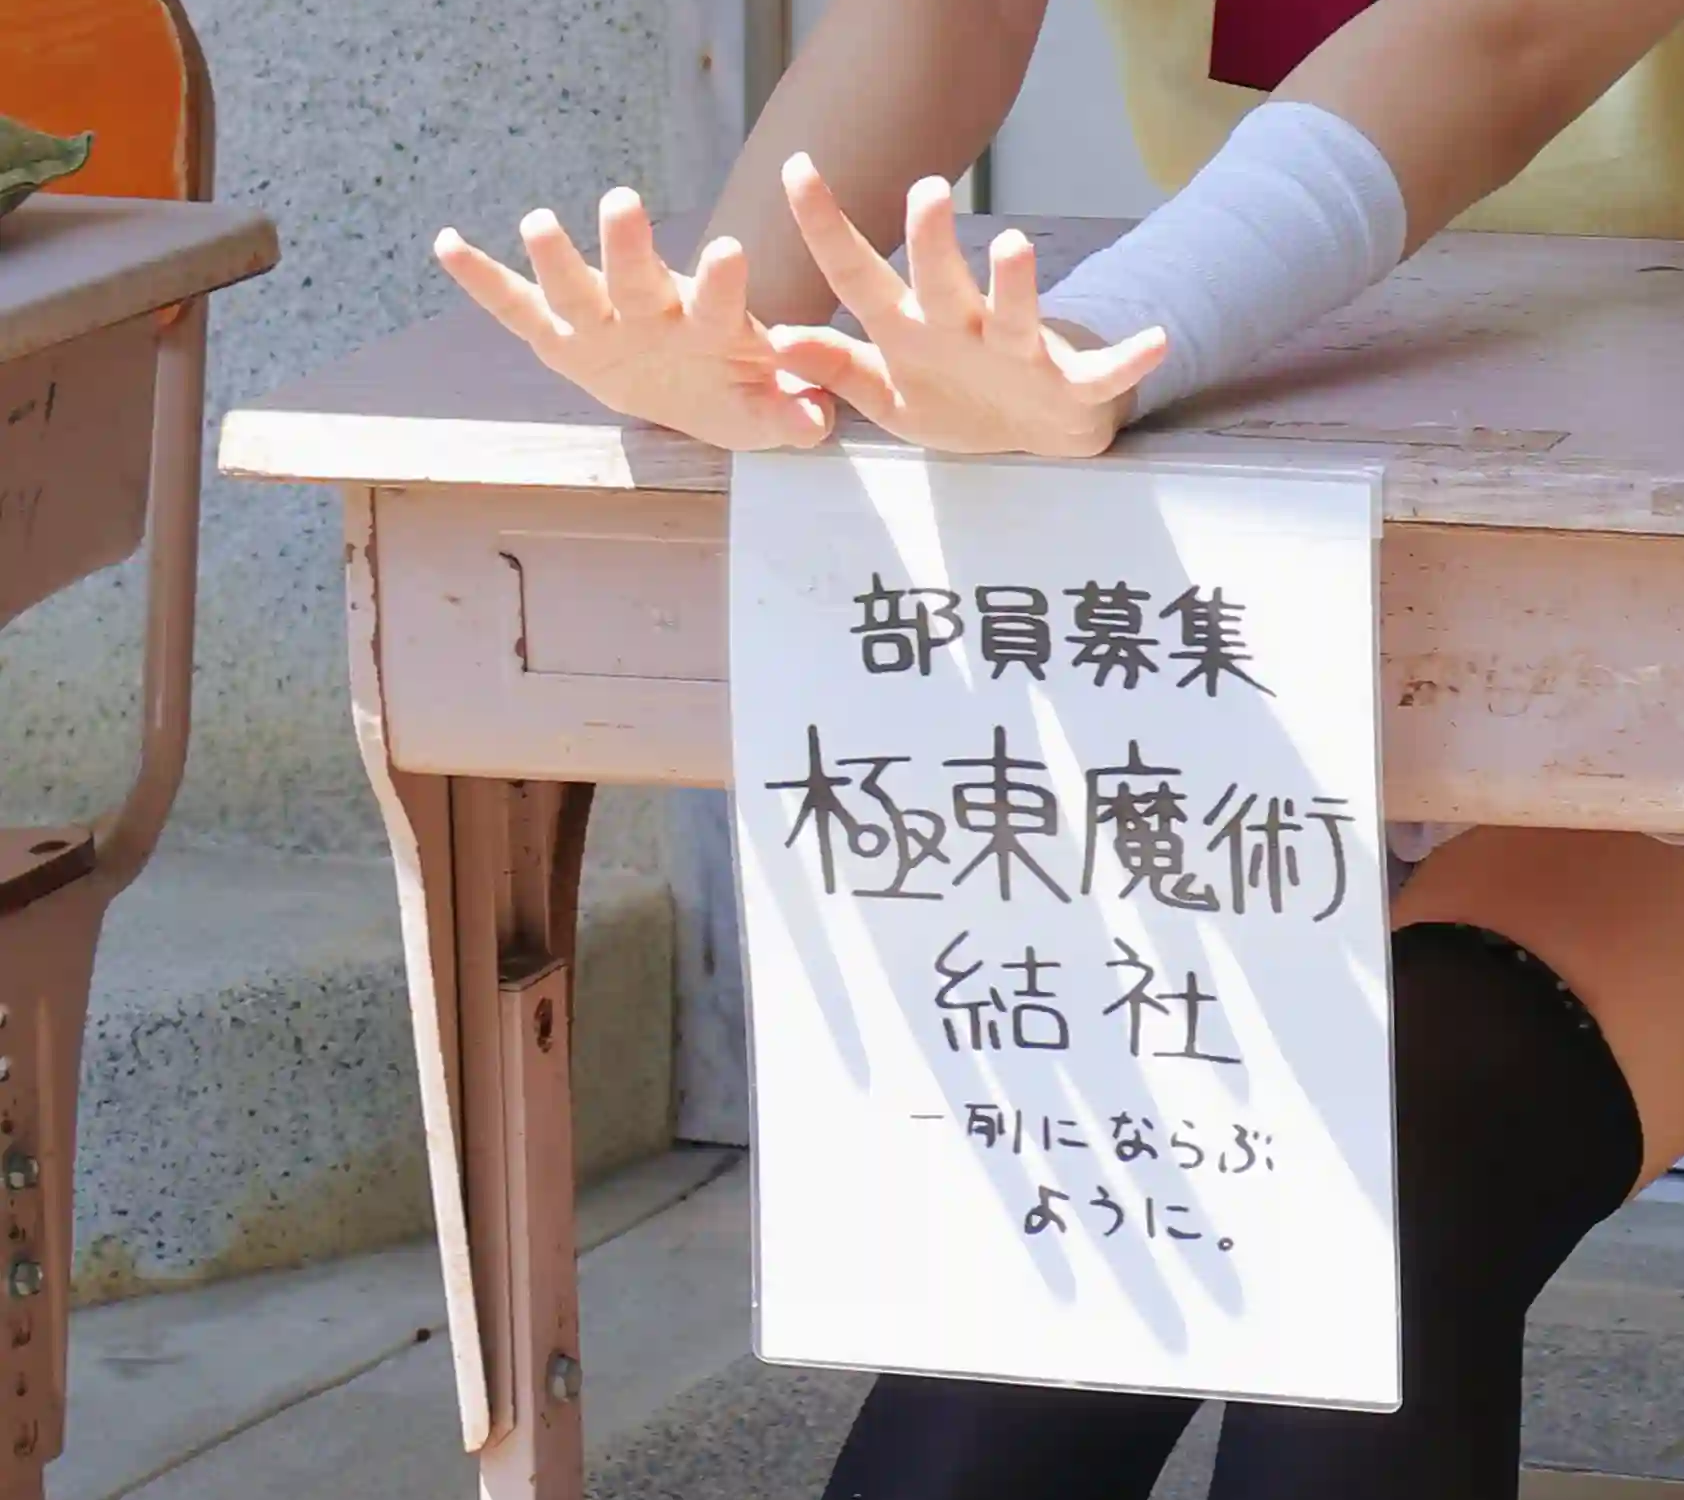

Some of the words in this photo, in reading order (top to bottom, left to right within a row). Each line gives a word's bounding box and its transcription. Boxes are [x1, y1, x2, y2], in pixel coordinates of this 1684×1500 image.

[850, 571, 1276, 698] 部員募集
[764, 724, 1356, 922] 極東魔術
[934, 931, 1241, 1064] 結社
[909, 1102, 1275, 1174] 一列にならぶ
[1023, 1184, 1235, 1252] ように。
